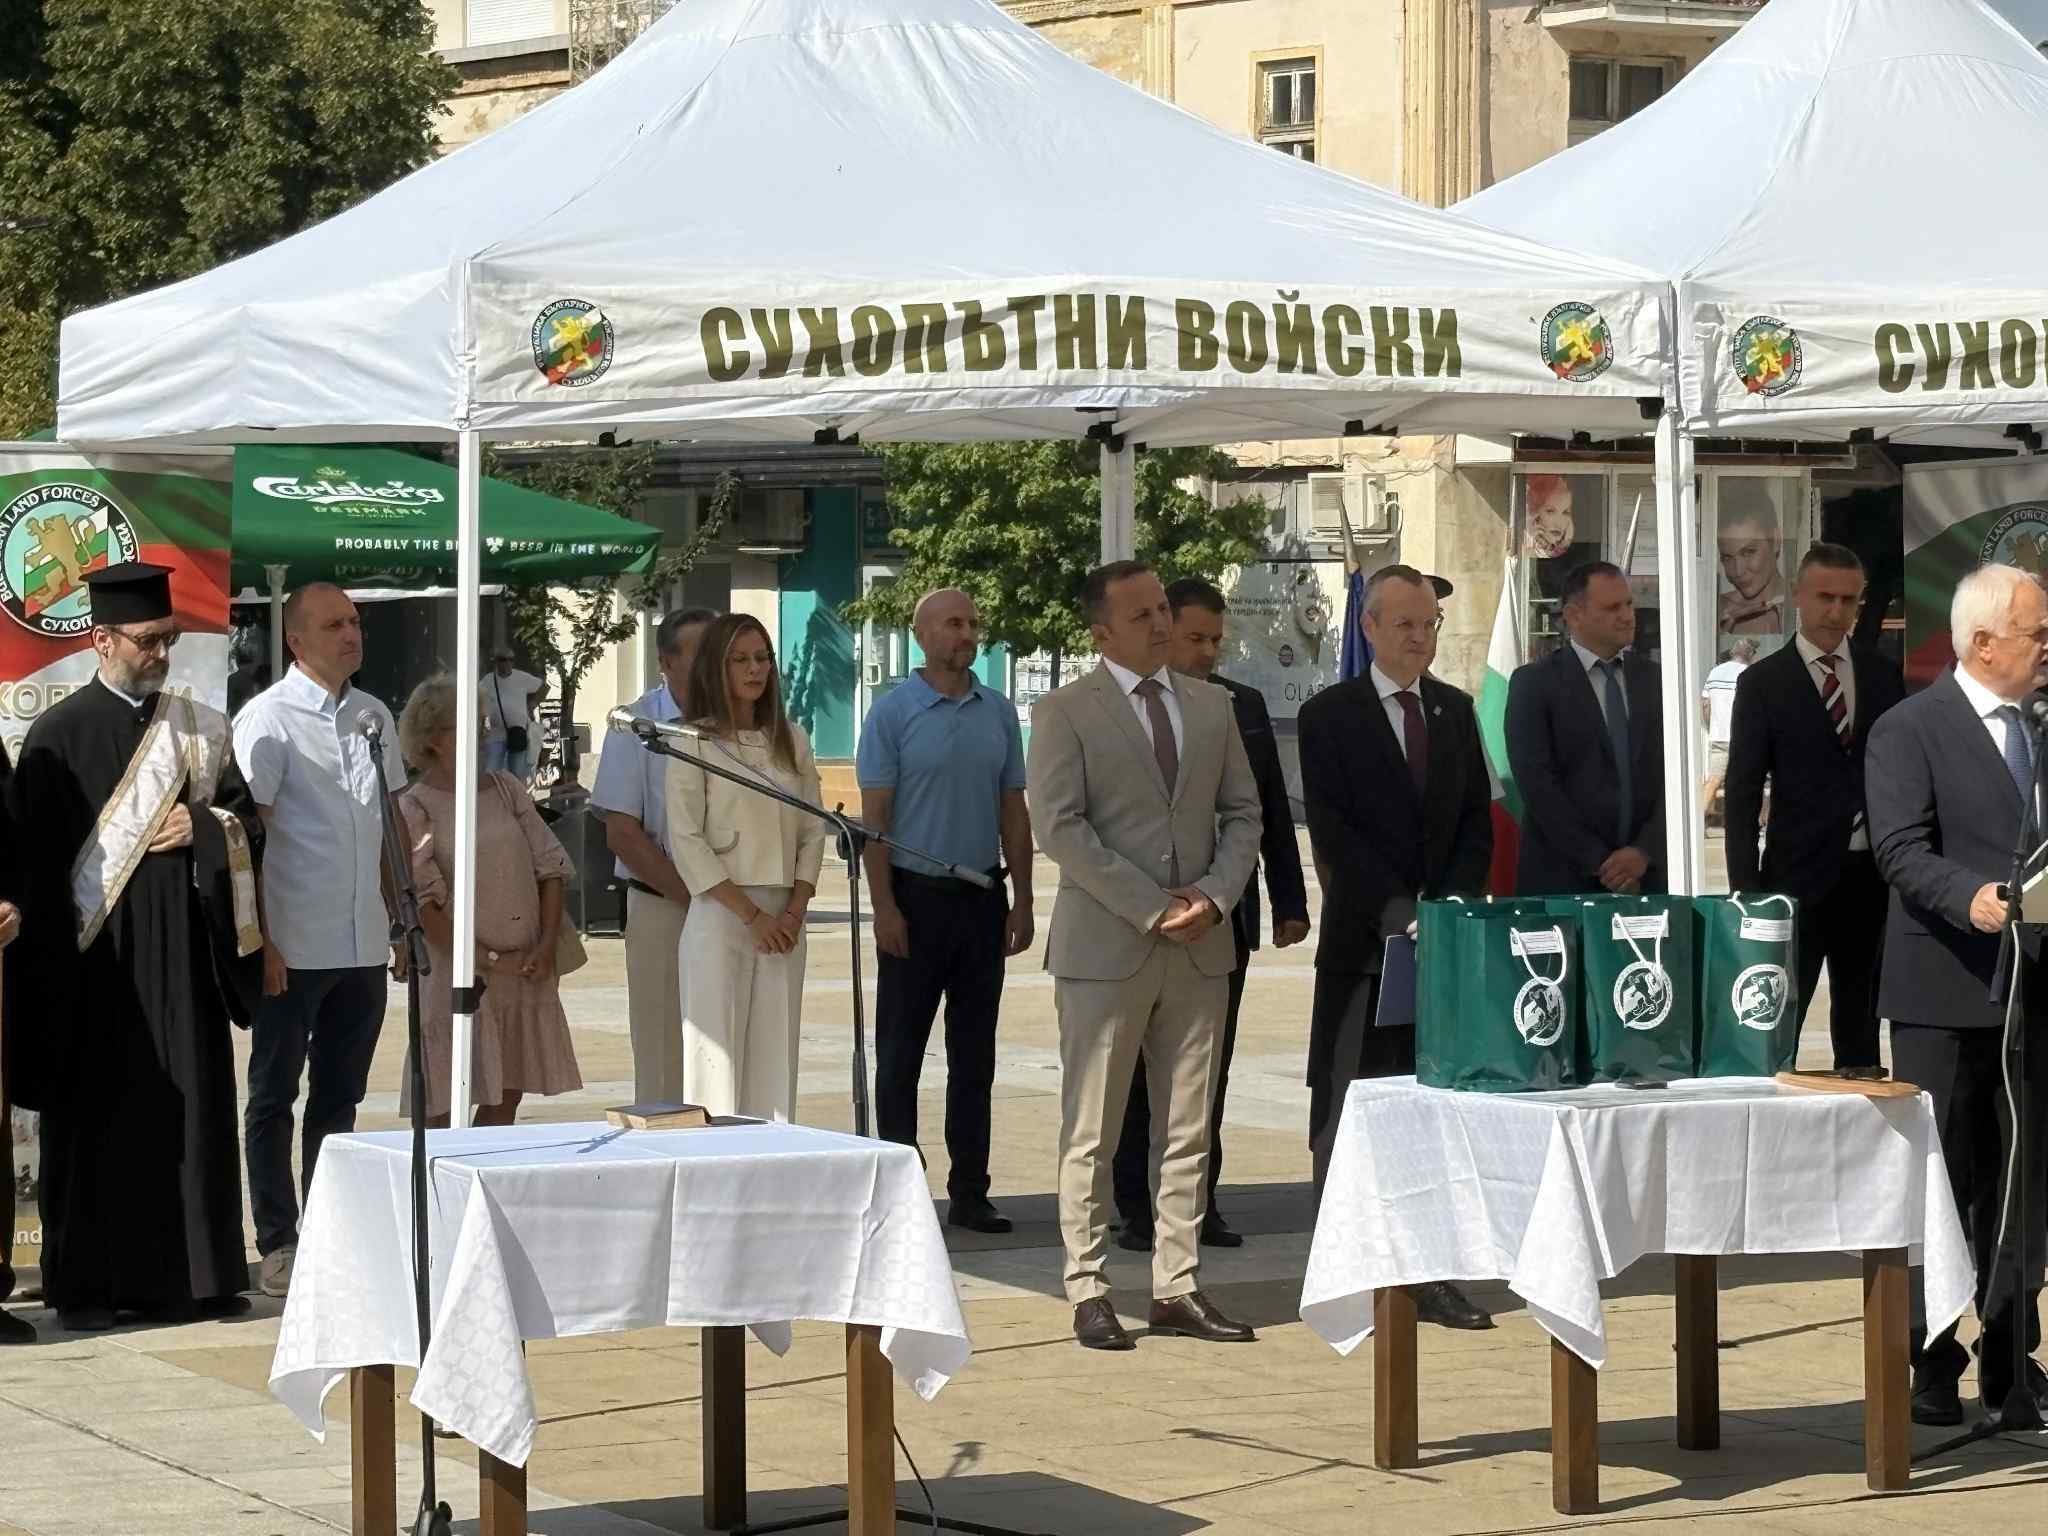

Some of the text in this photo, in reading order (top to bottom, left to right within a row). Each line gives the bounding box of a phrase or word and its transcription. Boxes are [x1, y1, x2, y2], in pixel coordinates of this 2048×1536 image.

[701, 294, 1147, 382] СУХОПЪТНИ
[1175, 289, 1463, 377] ВОЙСКИ
[1874, 318, 2048, 394] СУХО
[5, 486, 101, 524] LAND FORCES
[253, 476, 445, 506] Carlsberg
[2014, 510, 2048, 523] FORCE
[335, 538, 409, 550] PROBABLY
[413, 540, 440, 550] THE
[510, 541, 545, 552] BEER
[570, 543, 596, 554] THE
[600, 544, 645, 554] WORLD
